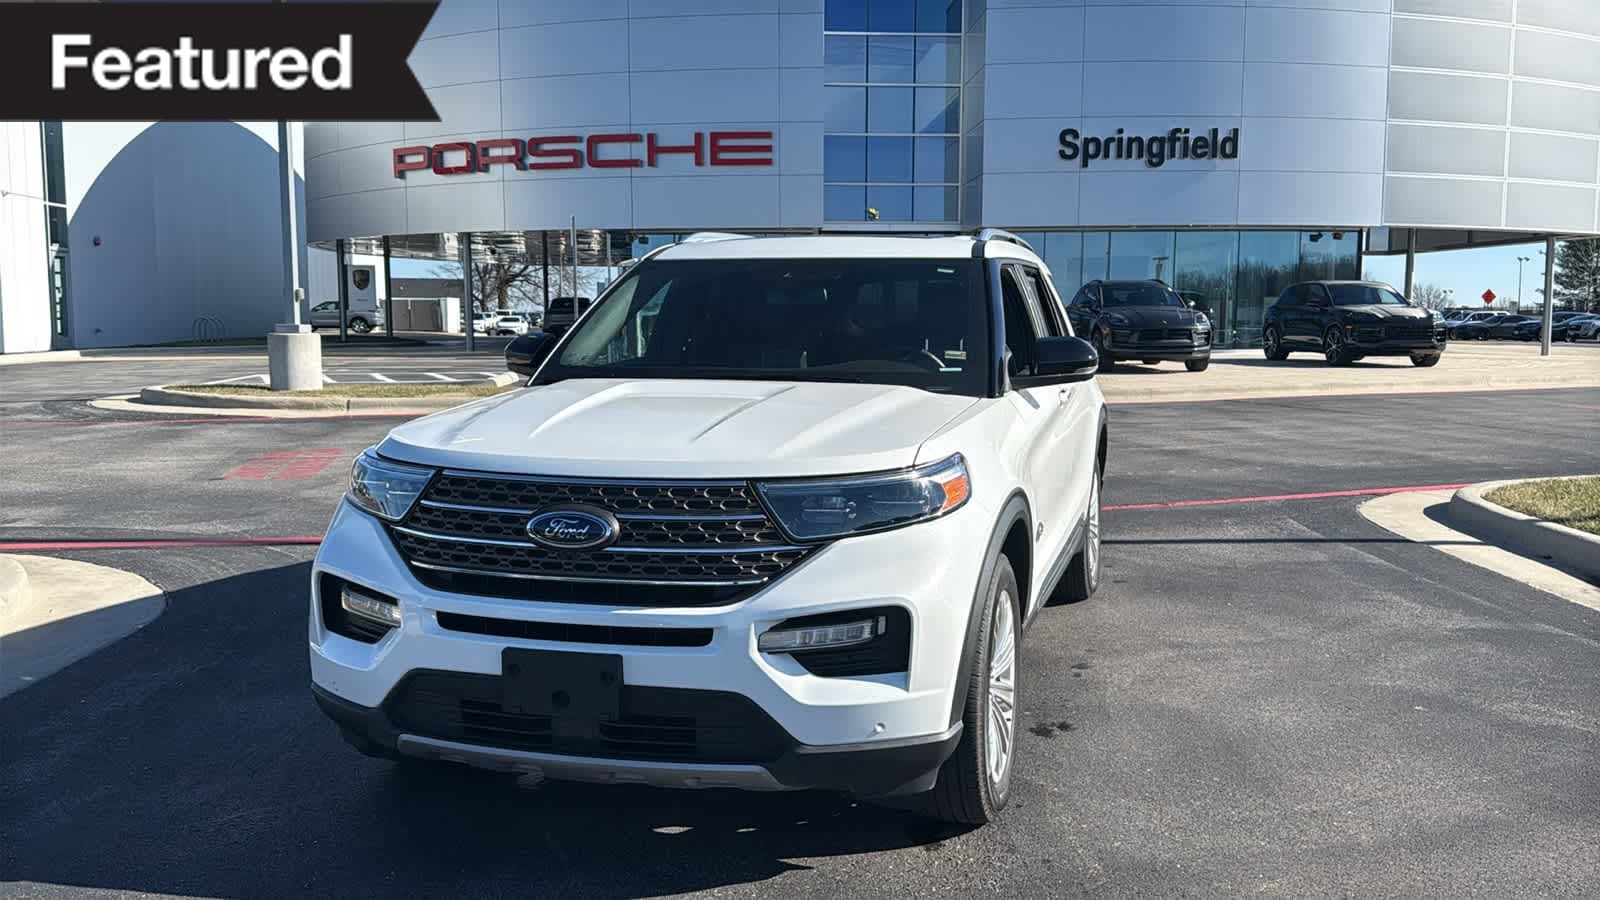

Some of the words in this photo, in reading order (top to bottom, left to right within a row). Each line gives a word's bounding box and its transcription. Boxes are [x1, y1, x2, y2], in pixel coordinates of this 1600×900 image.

[393, 131, 774, 179] PORSCHE
[1058, 127, 1240, 168] Springfield
[544, 517, 591, 540] Ford
